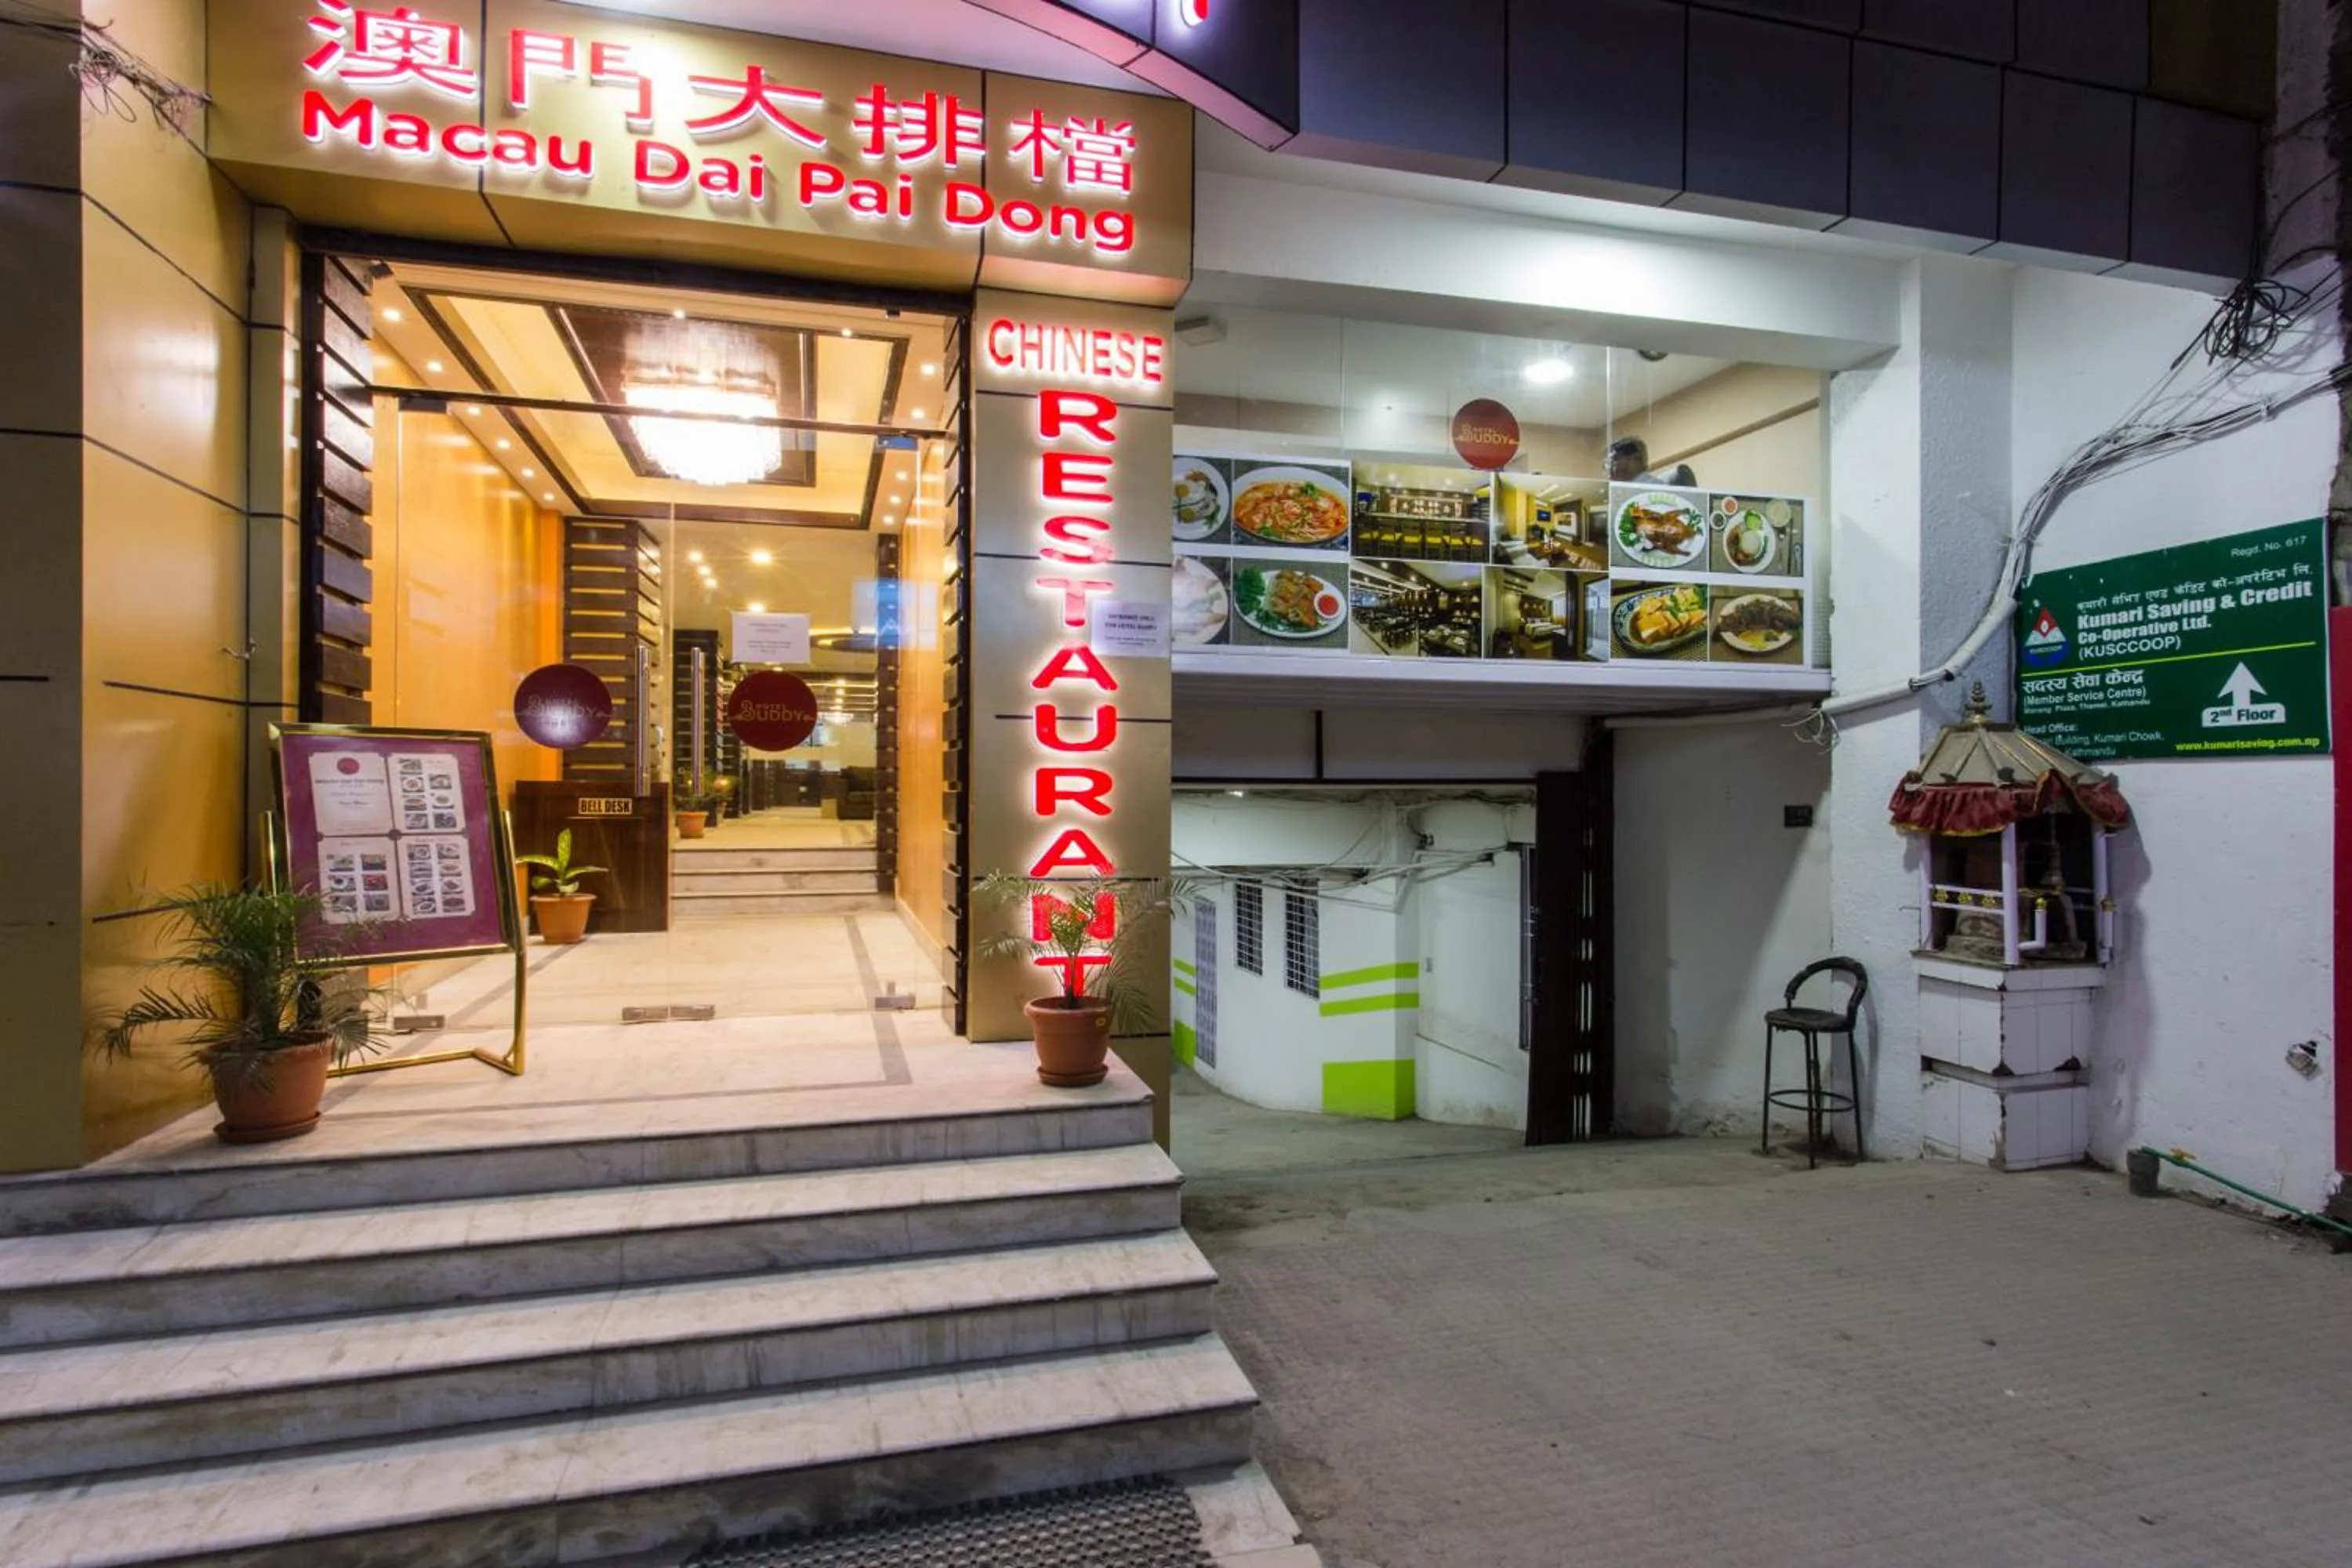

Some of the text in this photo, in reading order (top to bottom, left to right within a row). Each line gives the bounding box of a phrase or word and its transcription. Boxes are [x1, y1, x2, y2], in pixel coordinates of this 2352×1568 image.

[303, 89, 1135, 252] Macau Dai Pai Dong
[988, 318, 1163, 382] CHINESE
[2285, 535, 2307, 547] 617
[2078, 580, 2314, 630] Kumari Saving & Credit
[2078, 615, 2212, 644] Co-Operative Ltd.
[2078, 635, 2182, 660] (KUSCCOOP)
[1029, 390, 1120, 997] RESTAURANT
[2071, 673, 2100, 689] सेवा
[2024, 686, 2147, 706] (Member Service Centre)
[2209, 708, 2276, 724] 2nd Floor
[581, 799, 630, 813] BELL DESK
